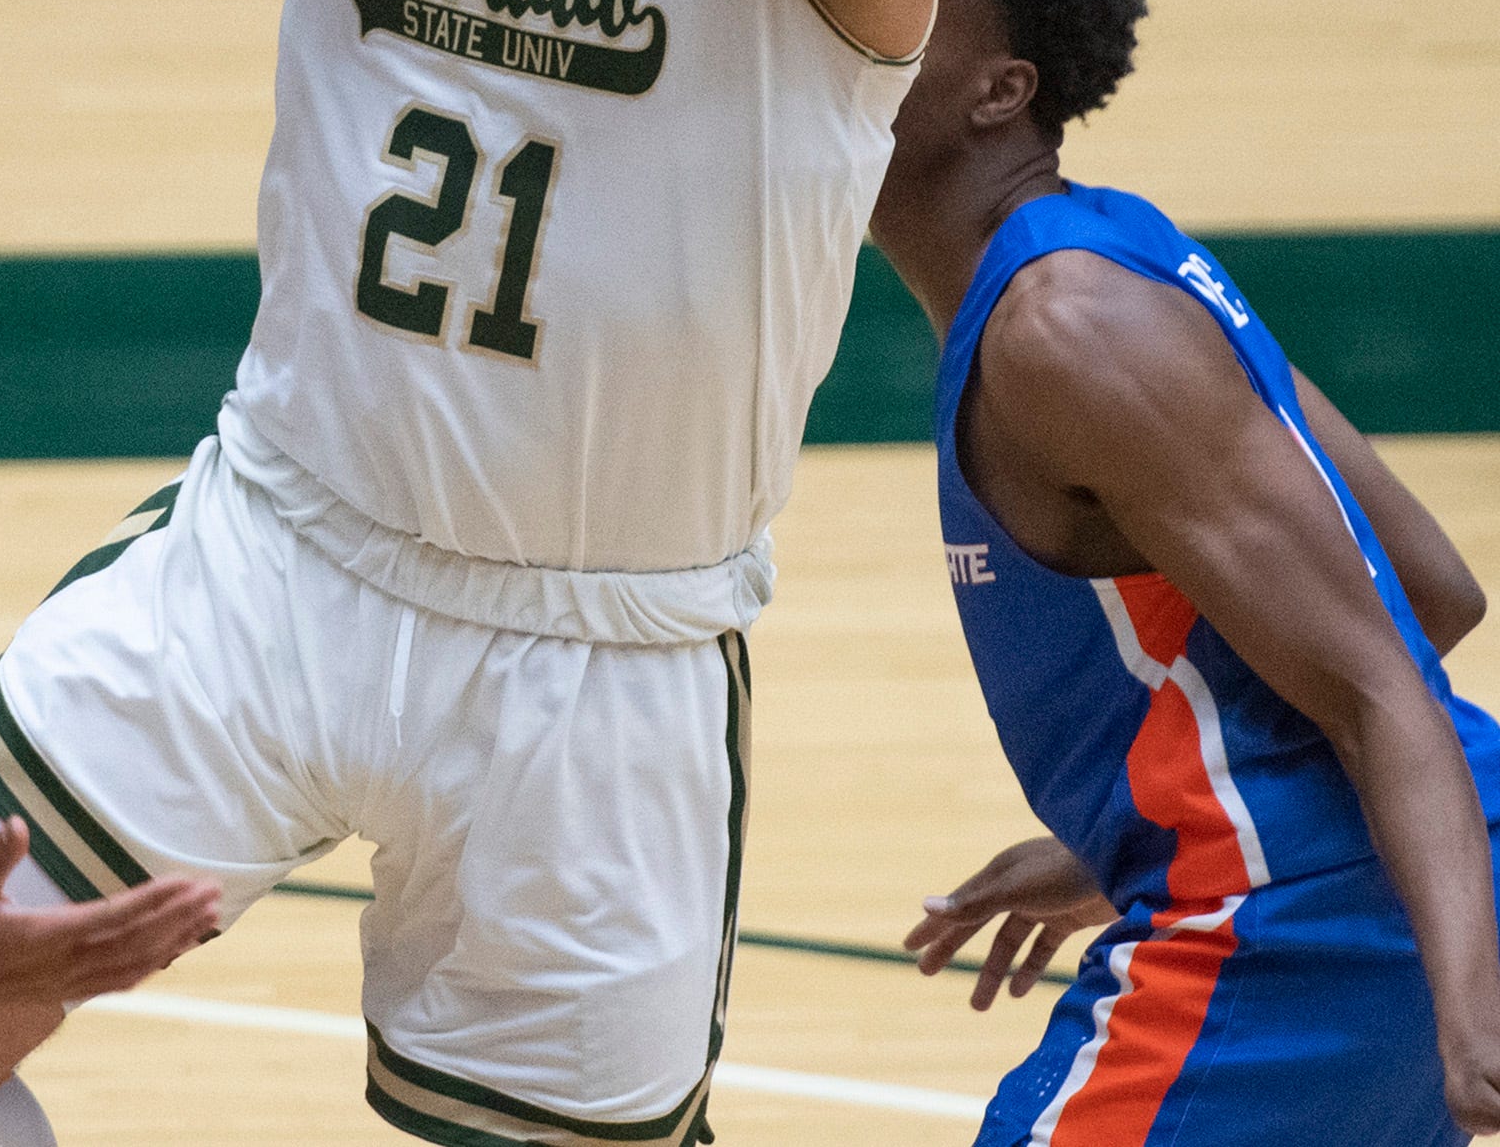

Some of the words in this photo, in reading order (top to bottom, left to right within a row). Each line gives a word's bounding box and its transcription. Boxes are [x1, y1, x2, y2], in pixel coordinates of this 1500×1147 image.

[403, 1, 488, 59] STATE
[502, 31, 576, 79] UNIV
[353, 99, 564, 372] 21
